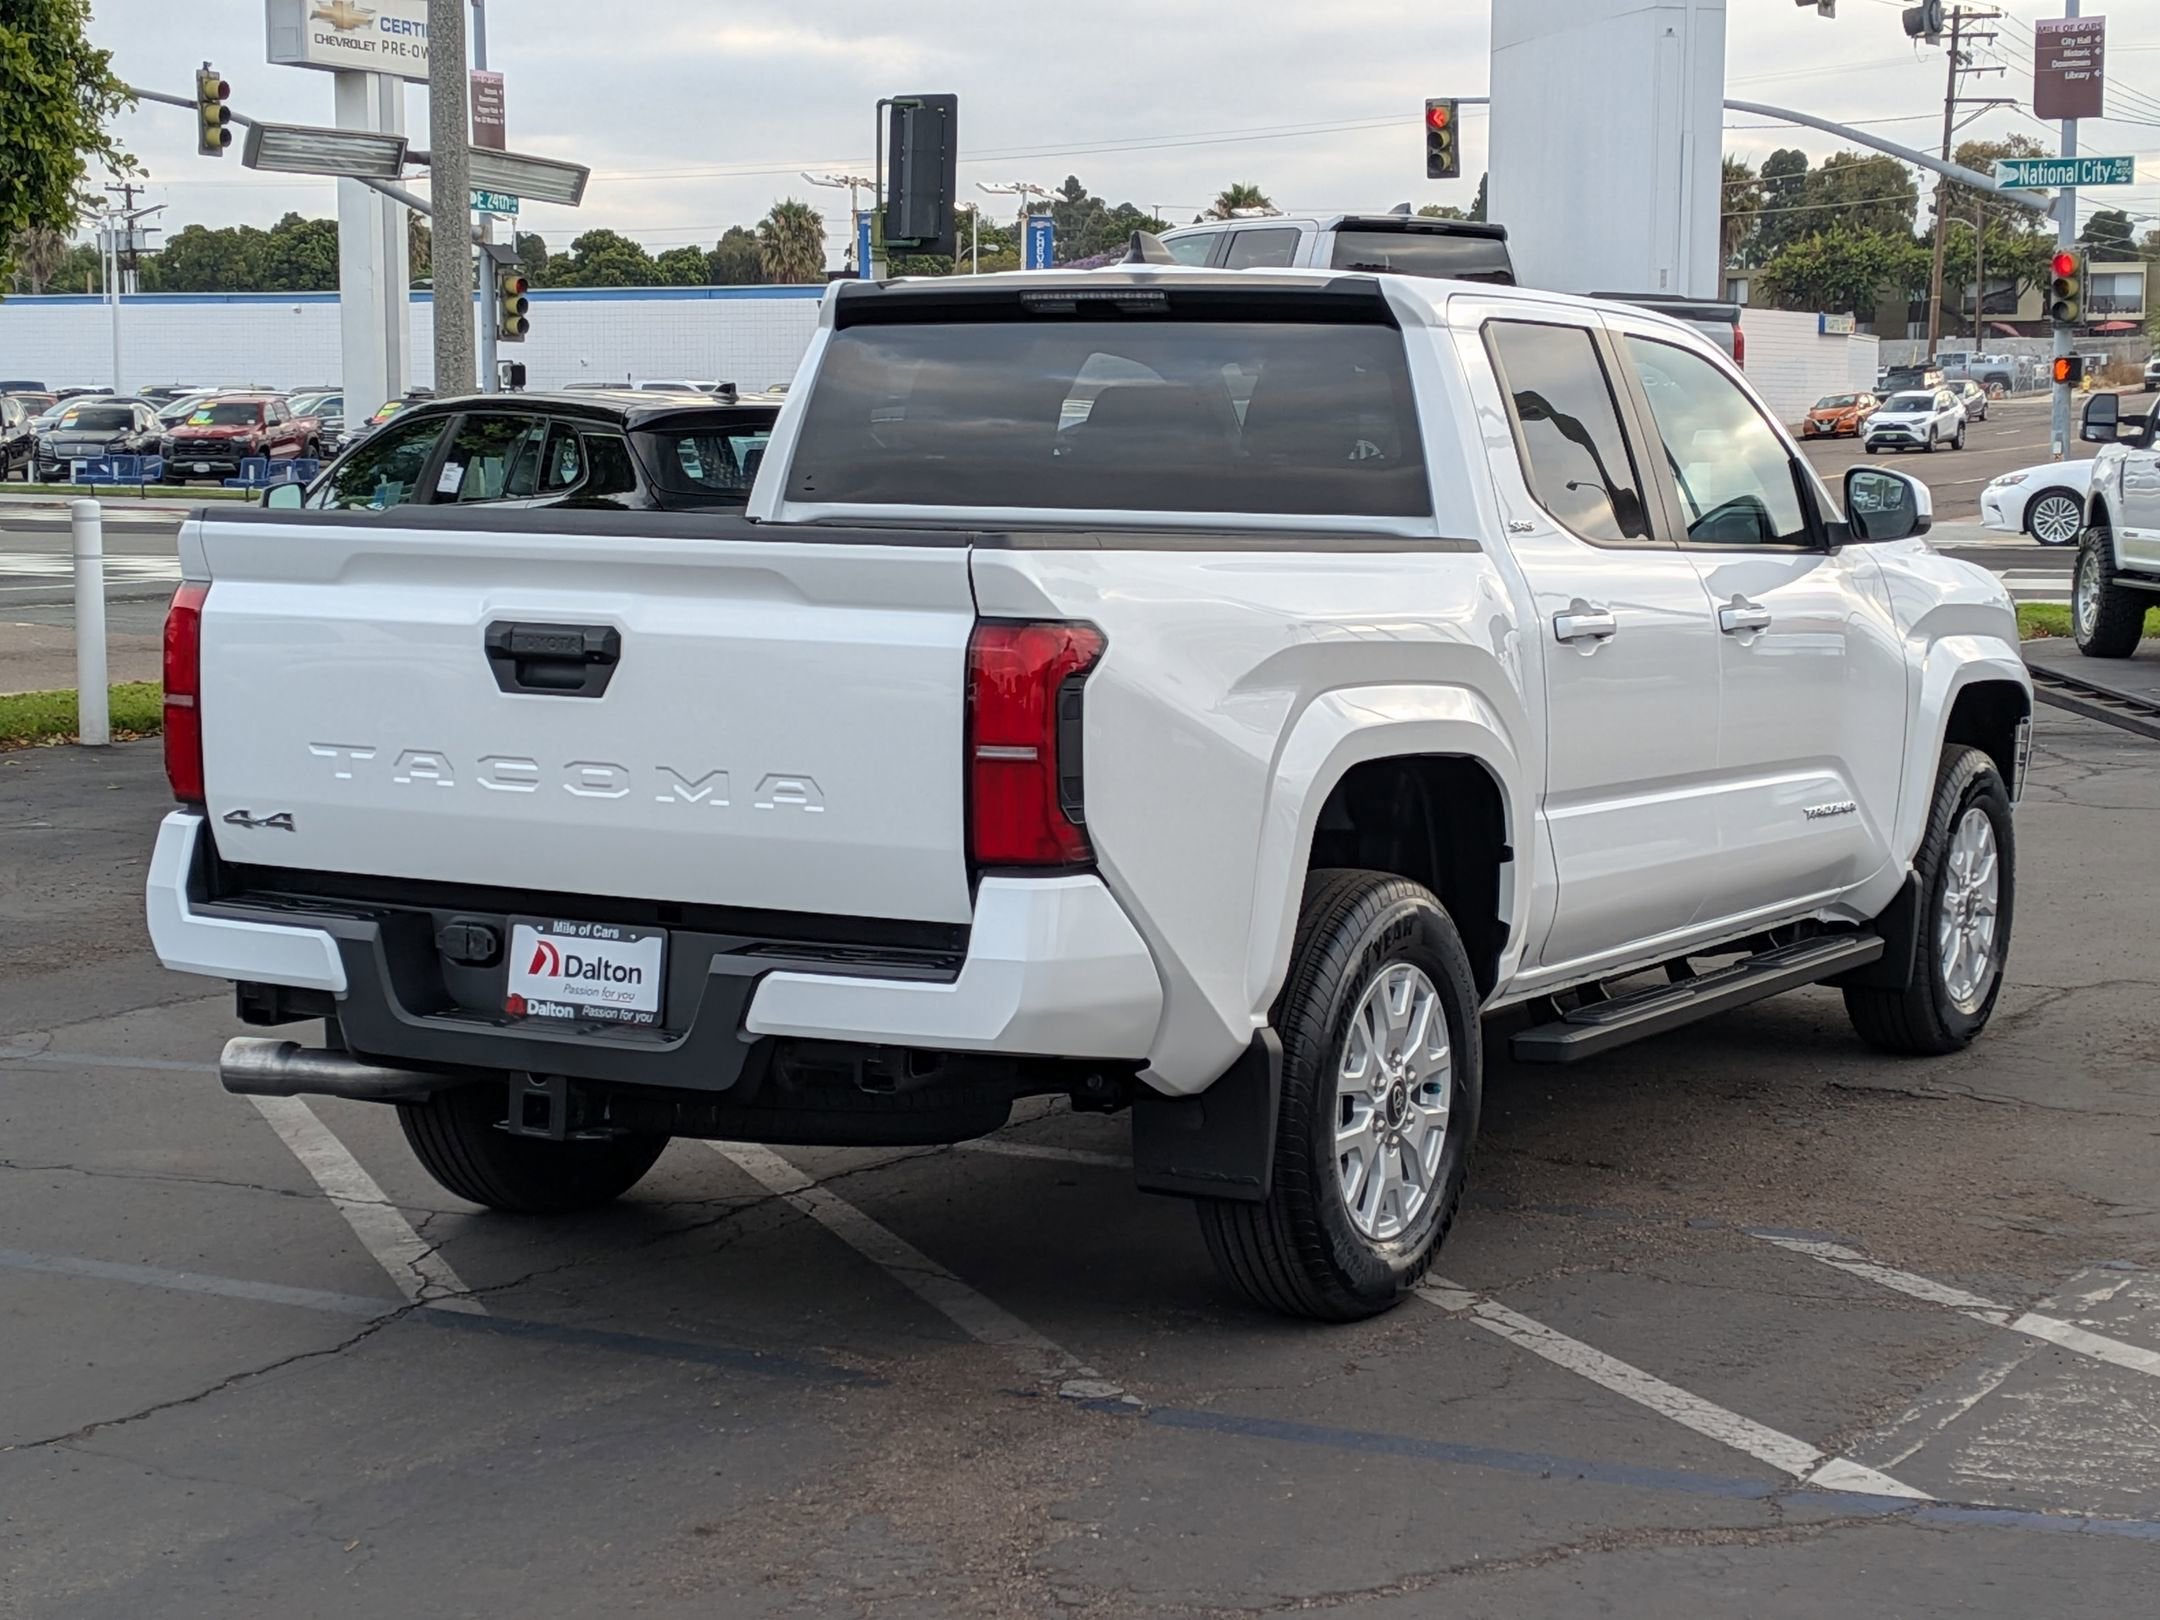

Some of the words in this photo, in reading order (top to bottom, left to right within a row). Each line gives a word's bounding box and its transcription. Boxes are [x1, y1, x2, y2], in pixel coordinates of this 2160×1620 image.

[380, 16, 429, 38] CERTI
[2063, 24, 2074, 32] OF
[2077, 22, 2103, 32] CARS
[314, 33, 377, 52] CHEVROLET
[381, 39, 429, 59] PRE-OW
[2061, 37, 2076, 47] City
[2065, 70, 2091, 80] Library
[2019, 161, 2079, 186] National
[2082, 160, 2112, 184] City
[487, 192, 510, 210] 24th
[1036, 230, 1045, 269] CHEVR
[309, 742, 825, 813] TACOMA
[552, 920, 576, 936] Mile
[578, 924, 592, 936] of
[593, 925, 620, 939] Cars
[564, 954, 642, 985] Dalton
[562, 983, 600, 997] Passion
[601, 986, 615, 998] for
[616, 990, 636, 1001] you
[526, 999, 575, 1018] Dalton
[582, 1005, 618, 1019] Passion
[619, 1008, 633, 1021] for
[633, 1012, 654, 1024] you
